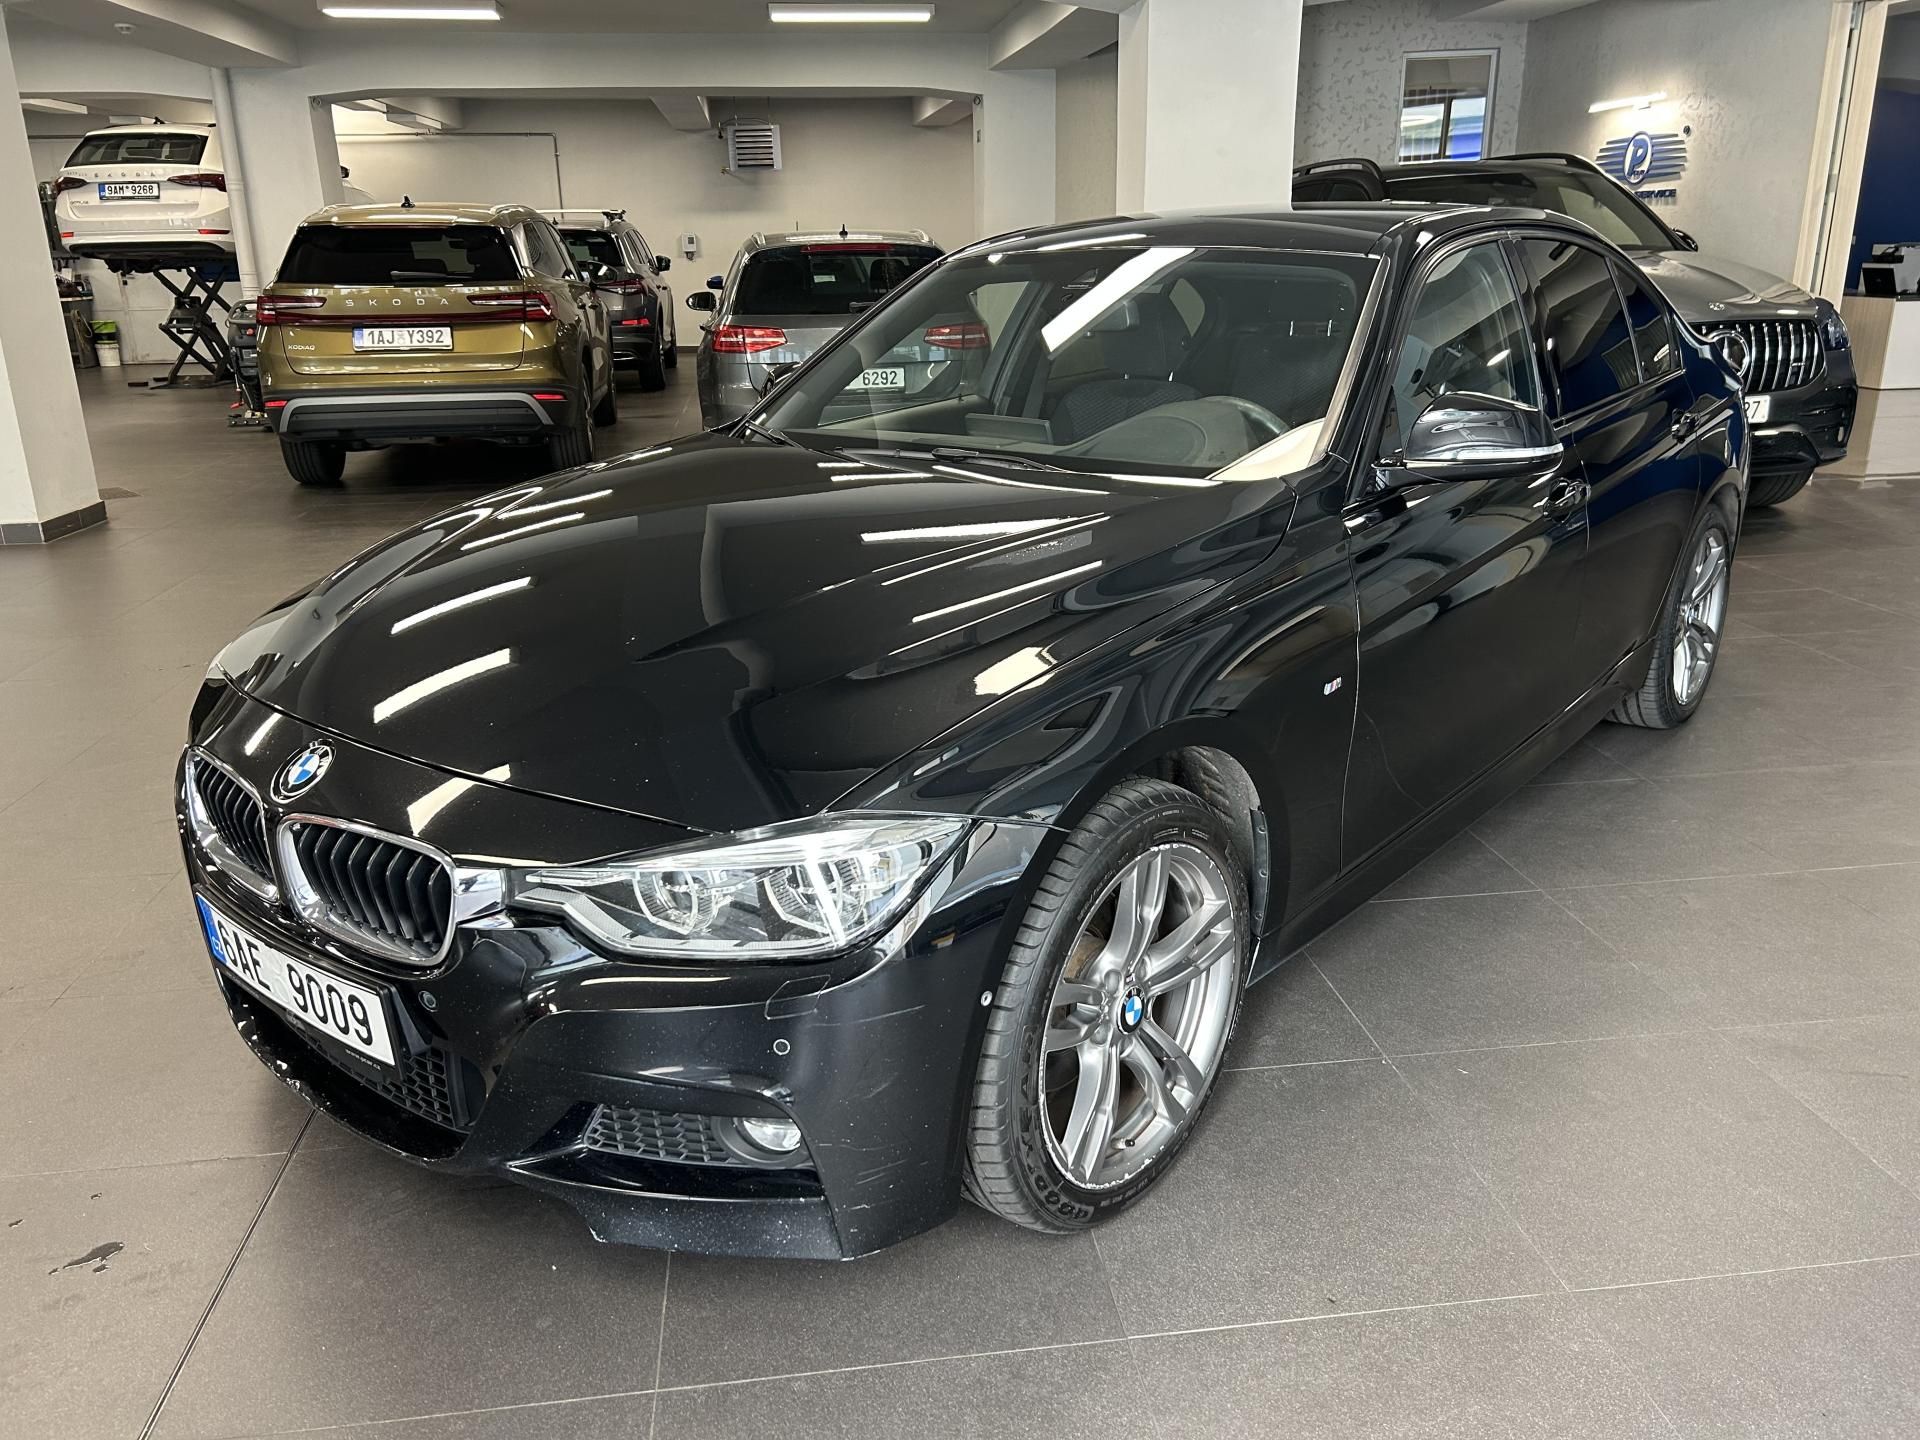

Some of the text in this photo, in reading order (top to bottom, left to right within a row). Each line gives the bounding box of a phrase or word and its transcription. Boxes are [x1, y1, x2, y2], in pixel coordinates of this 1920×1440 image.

[107, 185, 154, 195] 9AM 9268
[345, 298, 449, 307] SKODA
[367, 329, 444, 345] 1AJ Y392
[862, 370, 898, 386] 6292
[217, 919, 373, 1047] 6AE 9009
